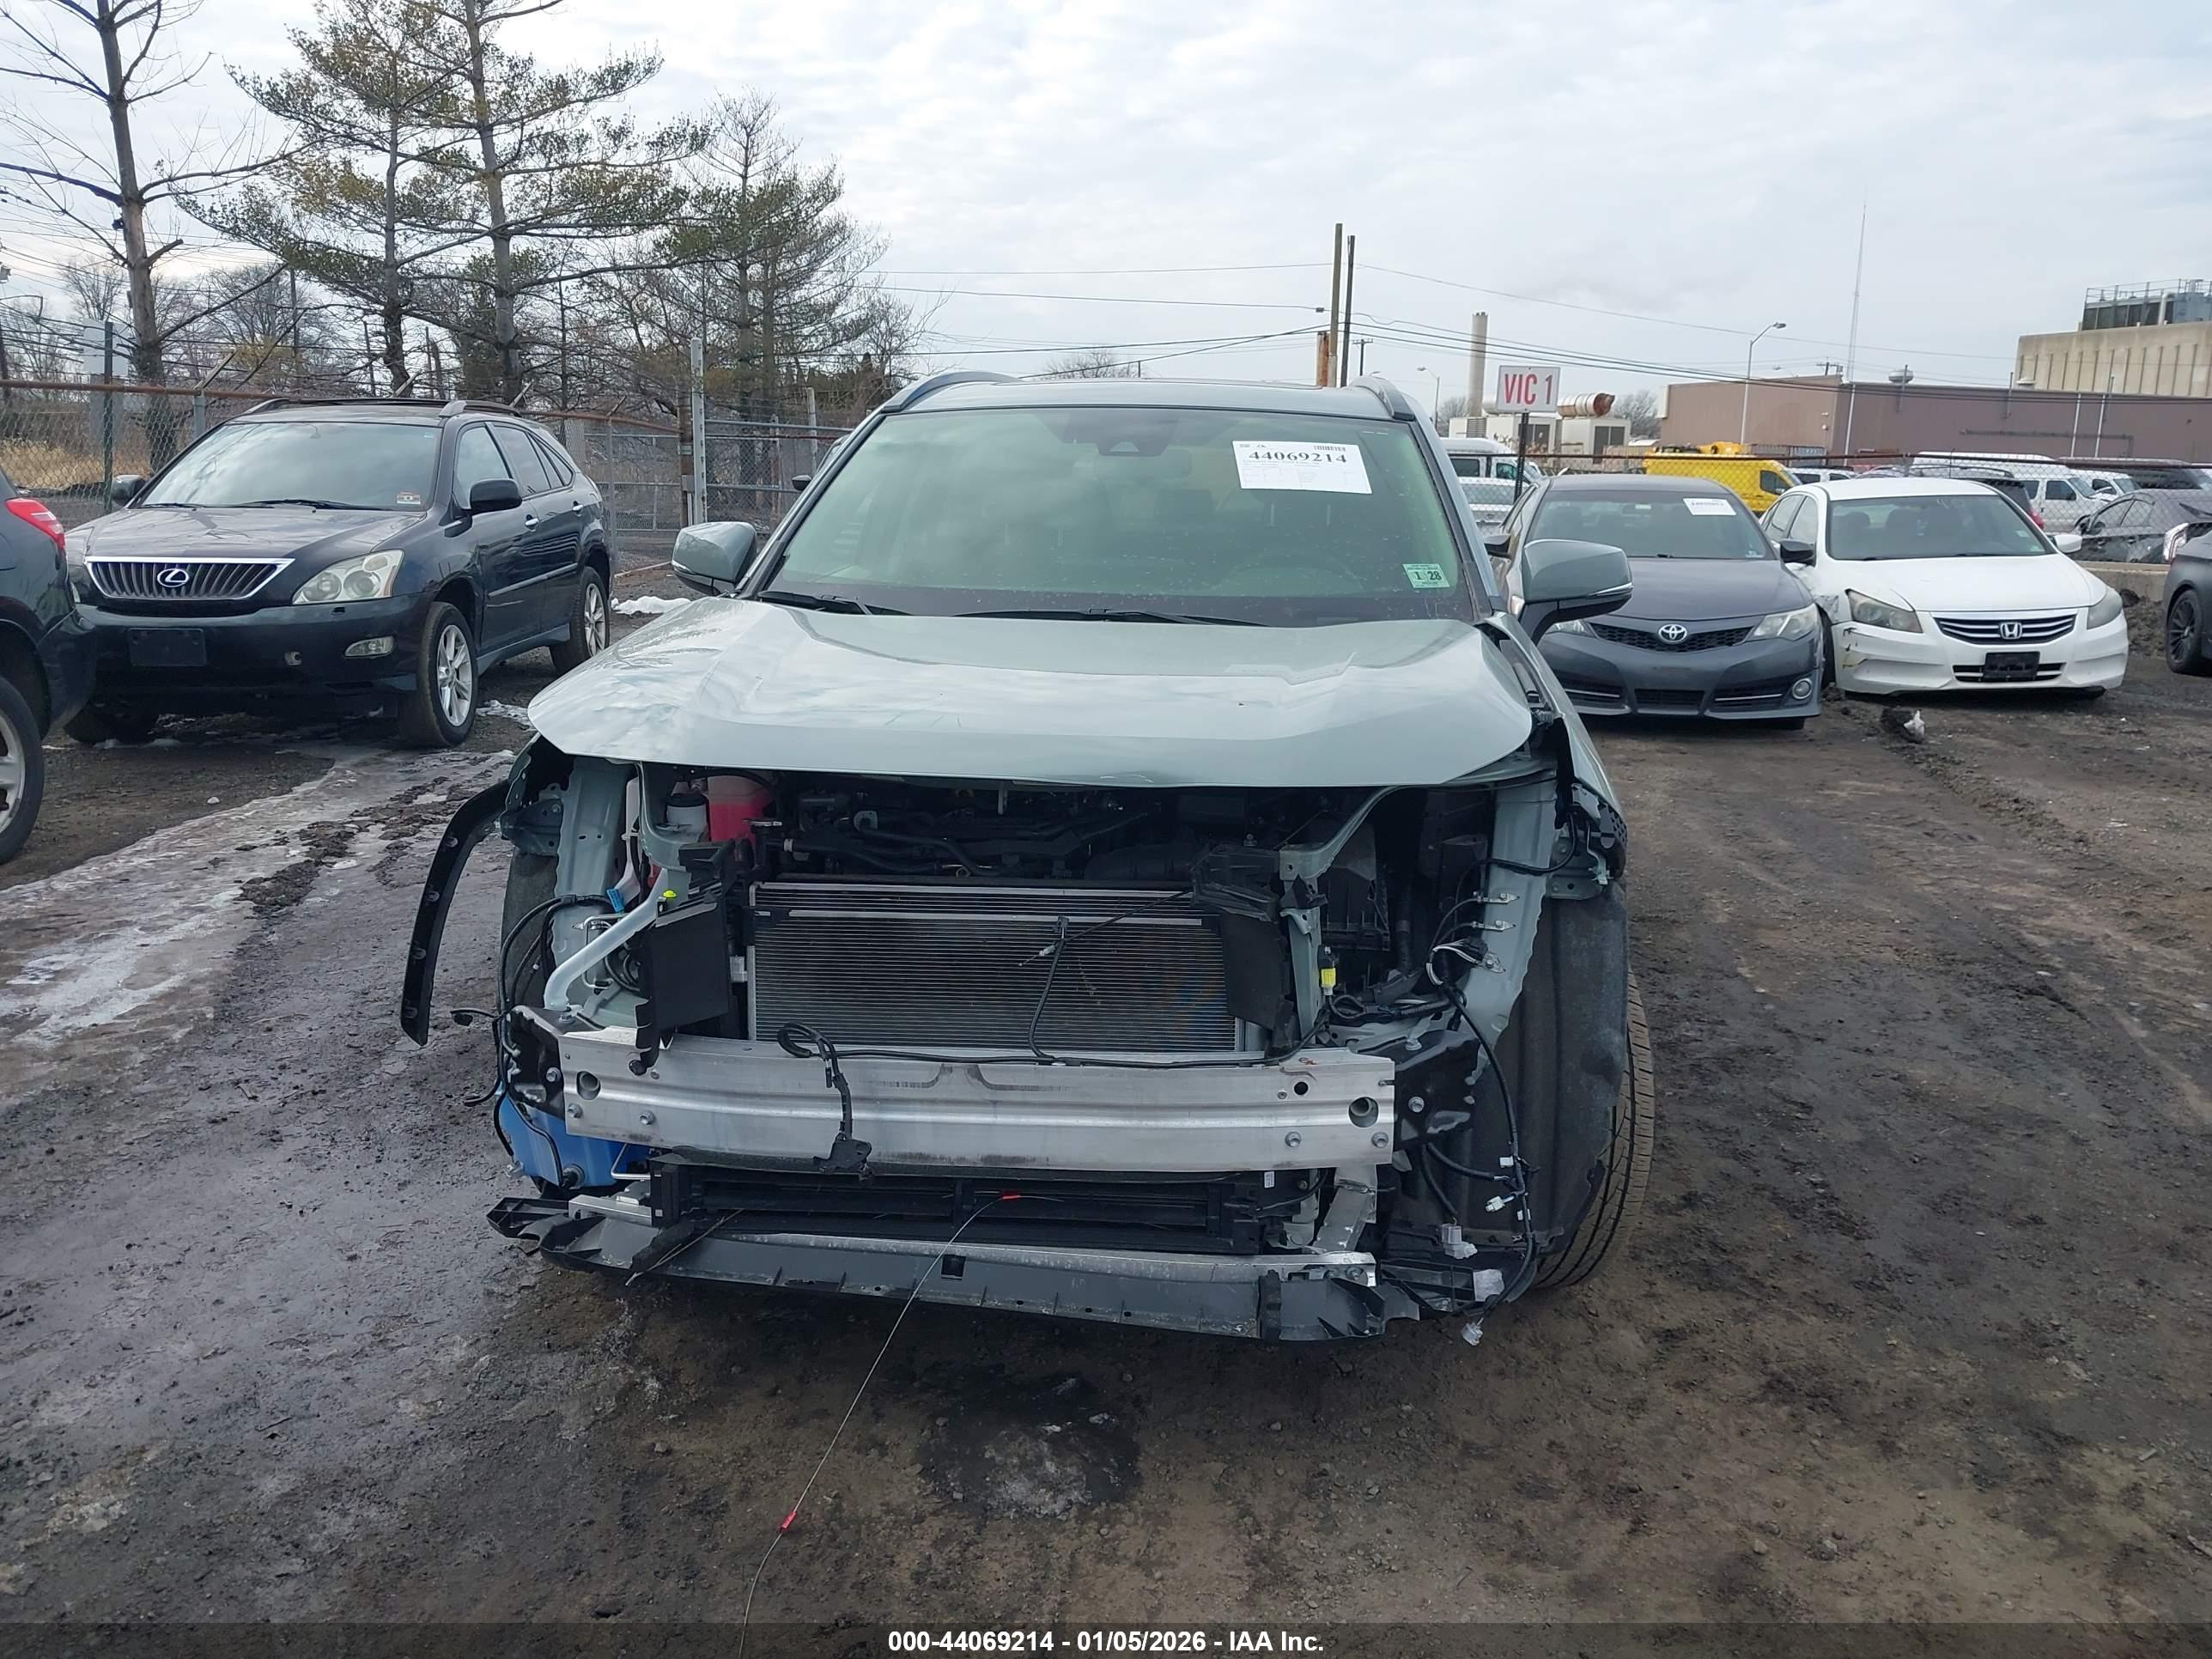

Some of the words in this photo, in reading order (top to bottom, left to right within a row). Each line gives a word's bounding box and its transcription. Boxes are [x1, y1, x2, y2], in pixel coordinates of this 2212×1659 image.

[1504, 374, 1538, 405] VIC
[1545, 374, 1553, 405] 1
[1249, 451, 1347, 464] 44069214
[1414, 571, 1423, 580] 1
[1427, 570, 1442, 580] 28
